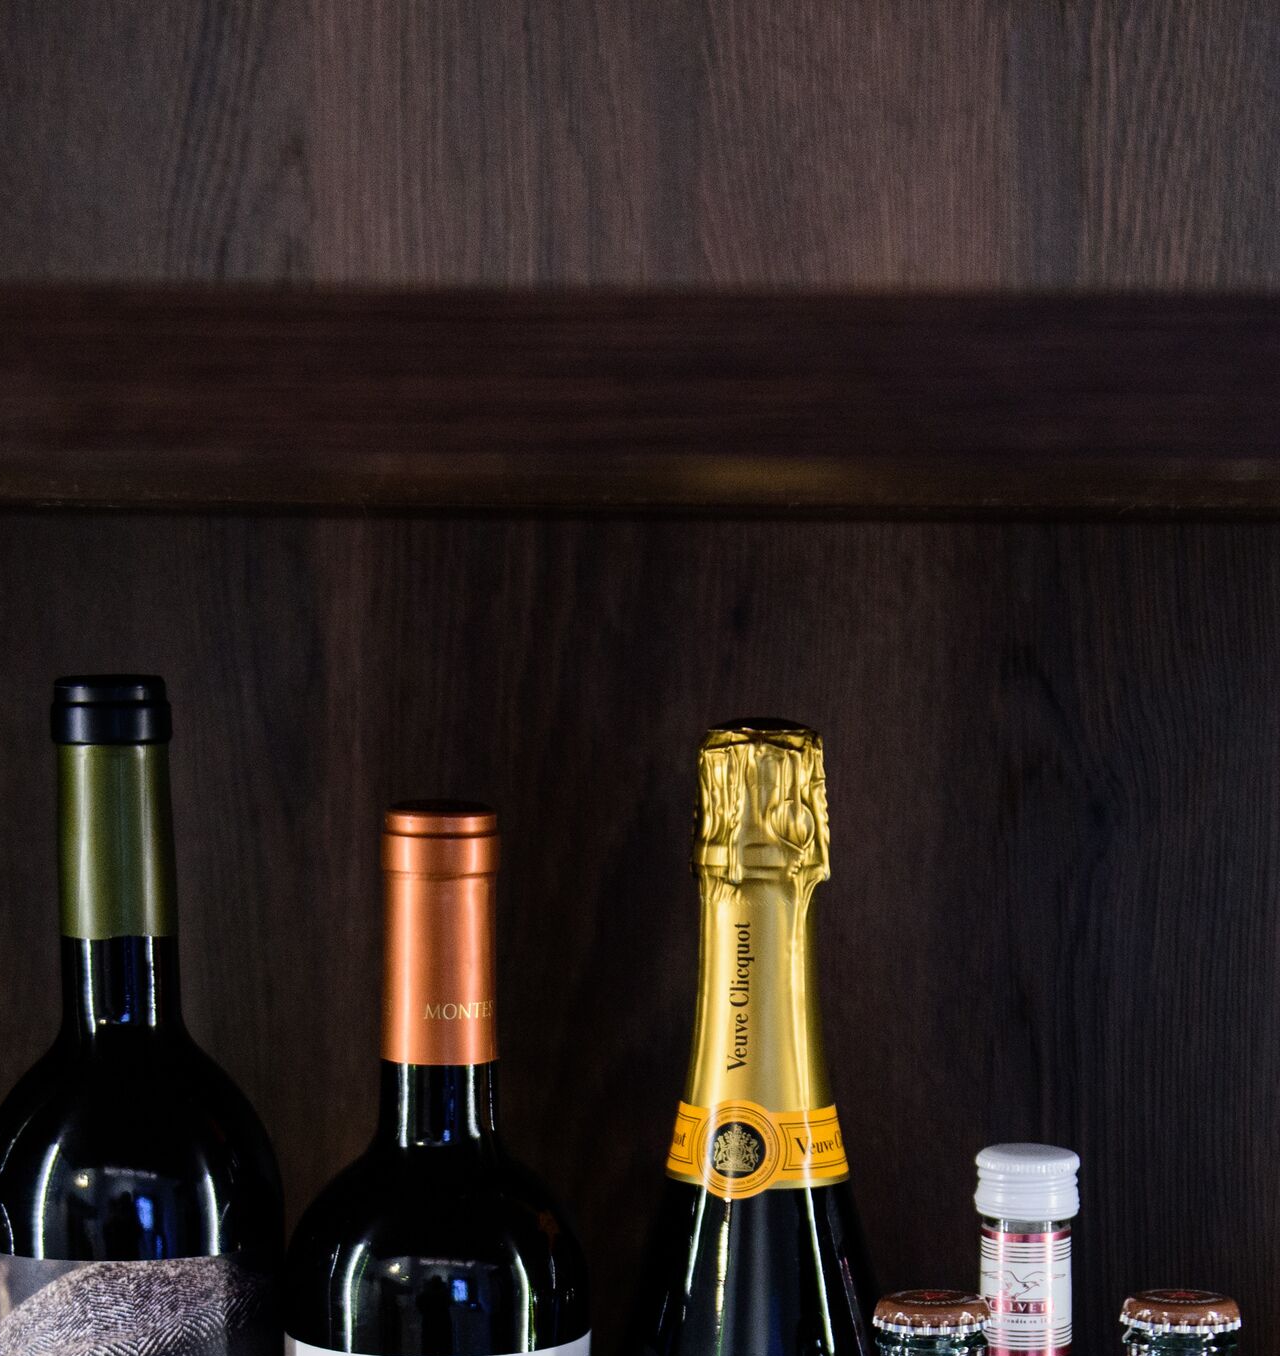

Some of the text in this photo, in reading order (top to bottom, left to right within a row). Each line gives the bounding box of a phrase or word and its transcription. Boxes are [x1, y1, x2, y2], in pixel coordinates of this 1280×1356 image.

[727, 921, 755, 1073] Veuve Clicquot
[794, 1134, 834, 1156] Veuve
